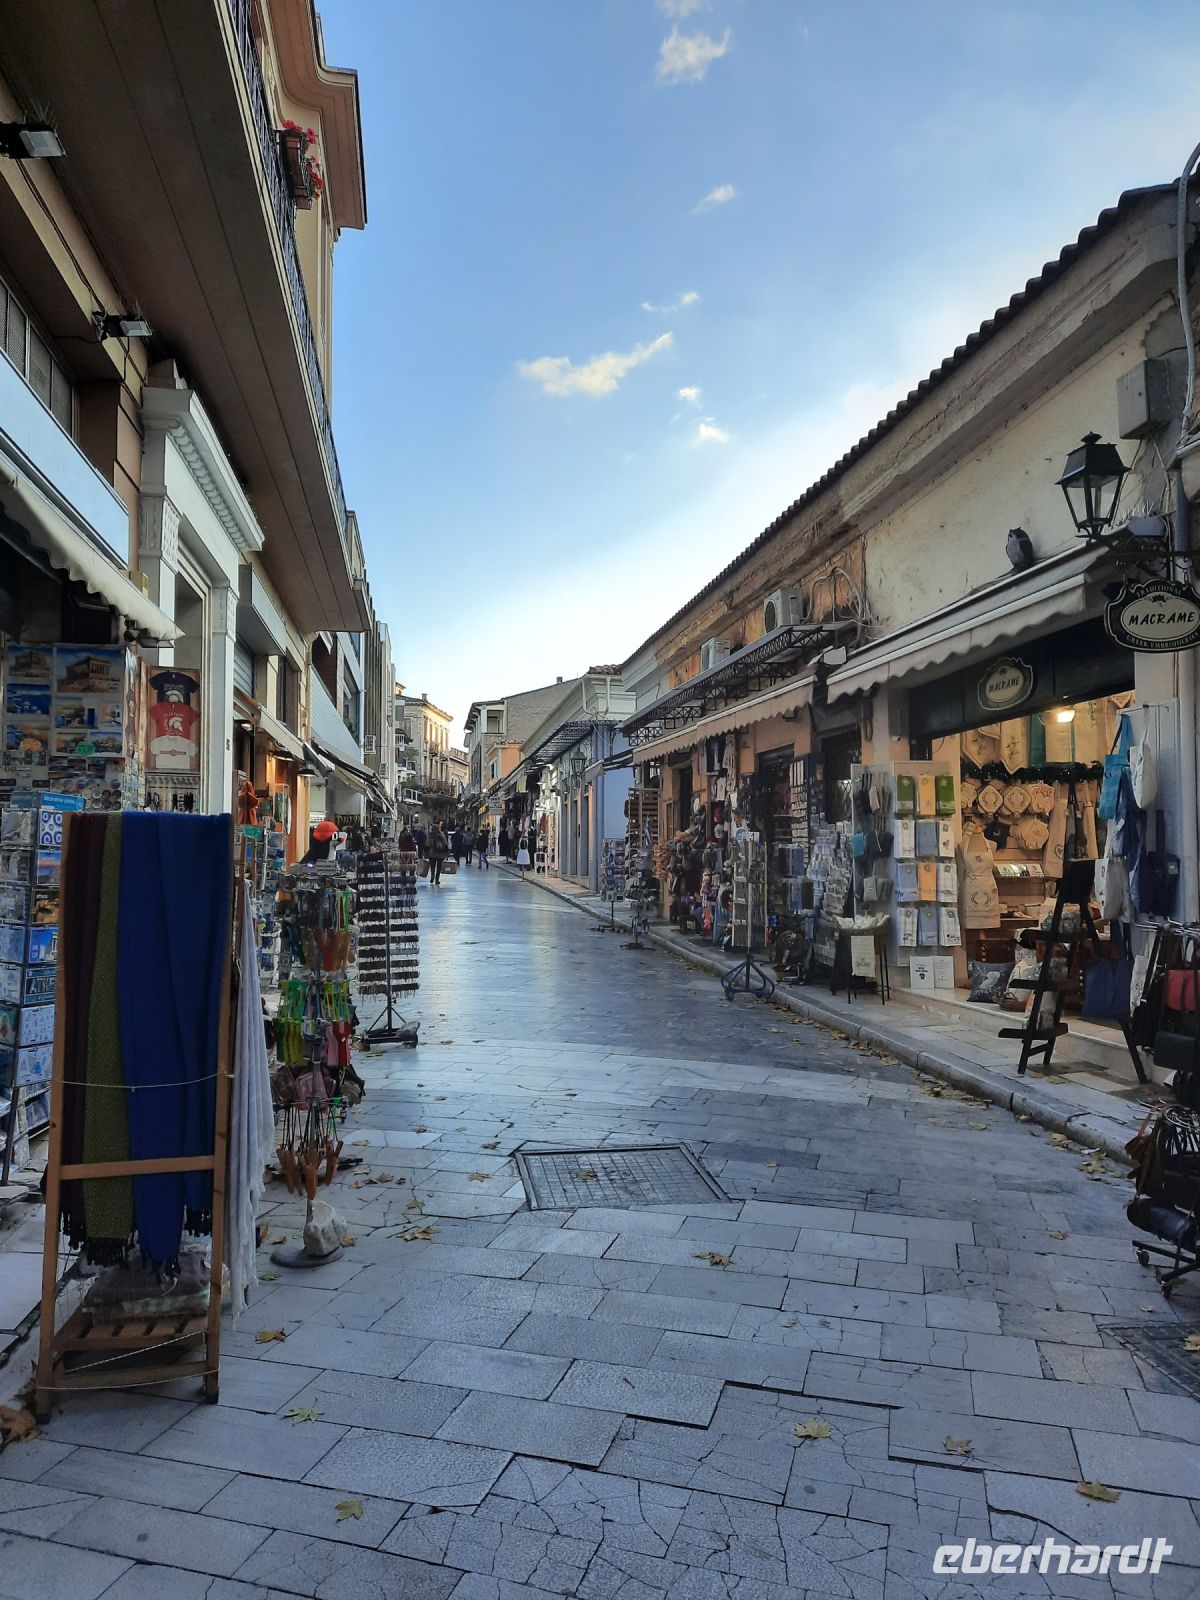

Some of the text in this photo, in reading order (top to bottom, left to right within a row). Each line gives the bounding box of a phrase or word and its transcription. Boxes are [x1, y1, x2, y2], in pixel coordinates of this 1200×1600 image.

[1128, 611, 1196, 626] MACRAME
[988, 675, 1020, 693] MACRAME
[30, 976, 56, 994] ATHE
